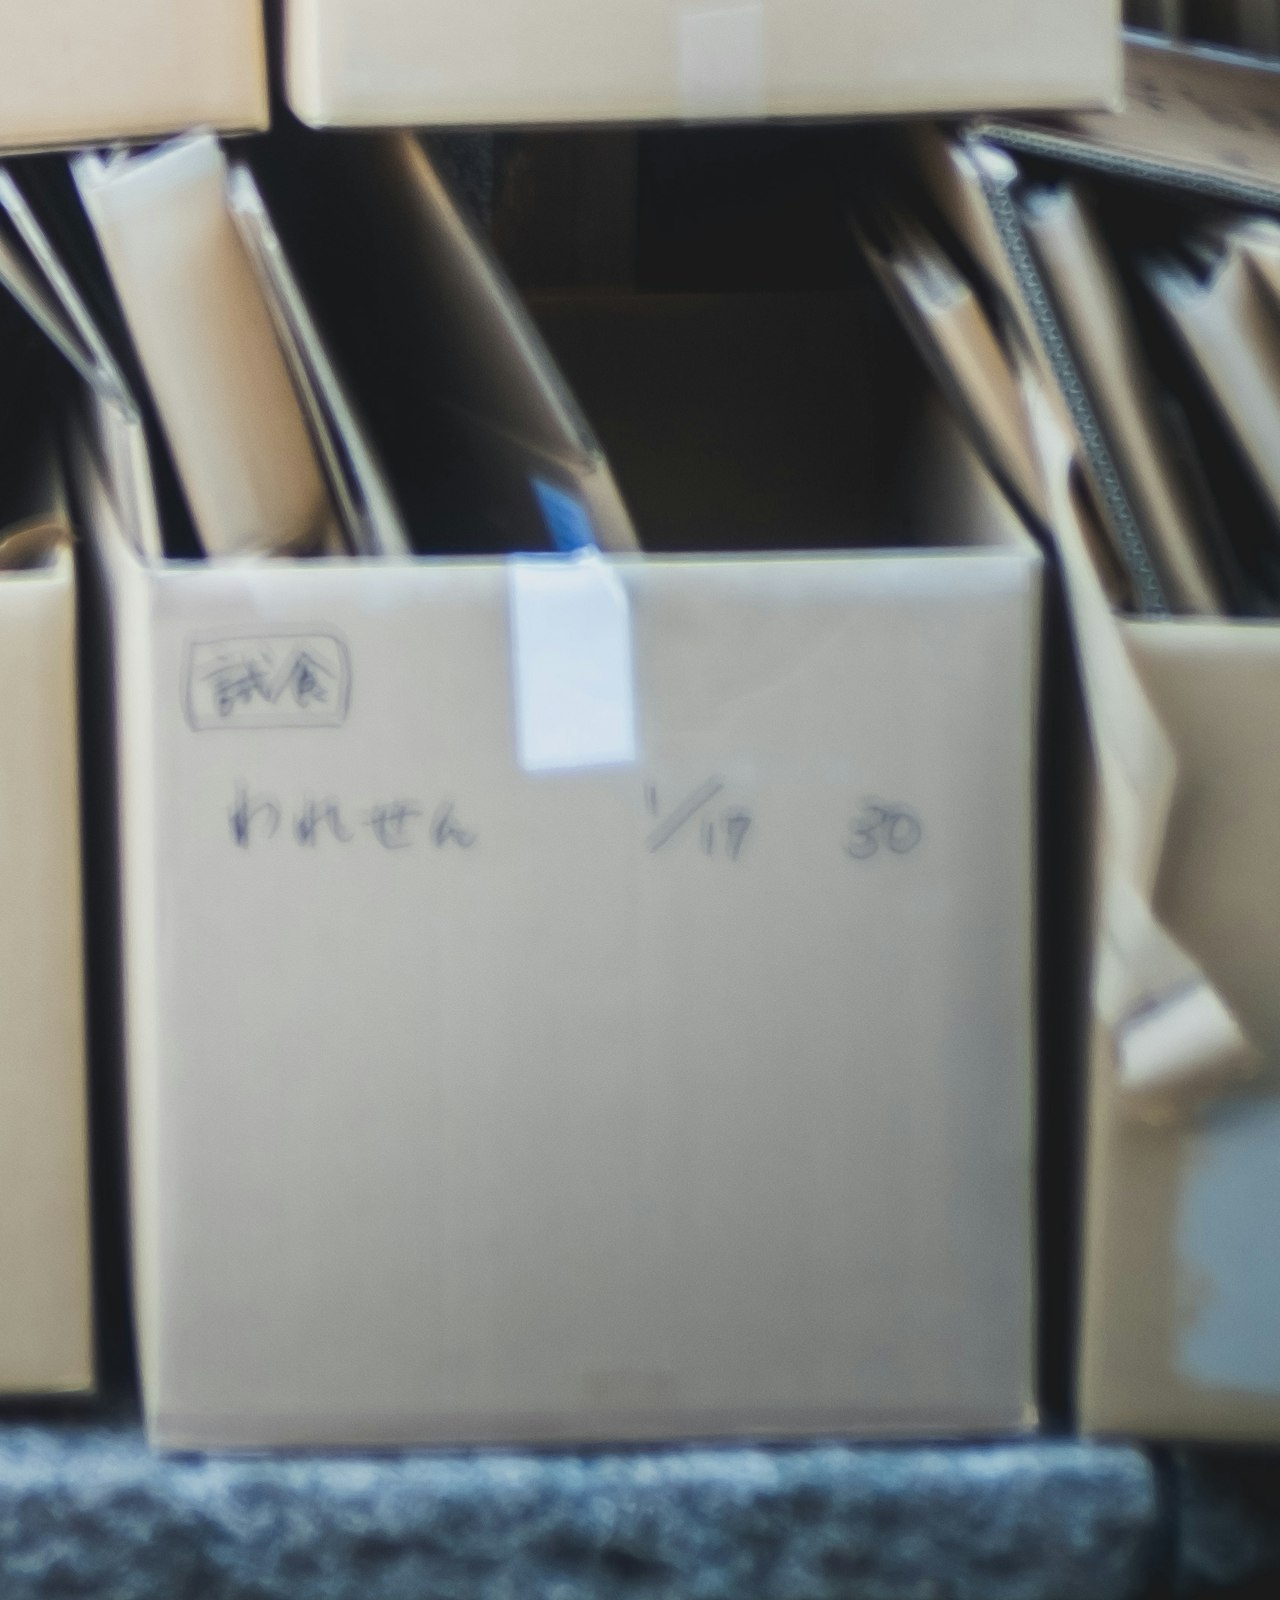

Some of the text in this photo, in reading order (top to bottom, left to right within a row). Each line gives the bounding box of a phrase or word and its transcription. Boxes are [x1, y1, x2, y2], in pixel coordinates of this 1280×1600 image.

[227, 792, 478, 852] われせん
[848, 800, 923, 862] 30
